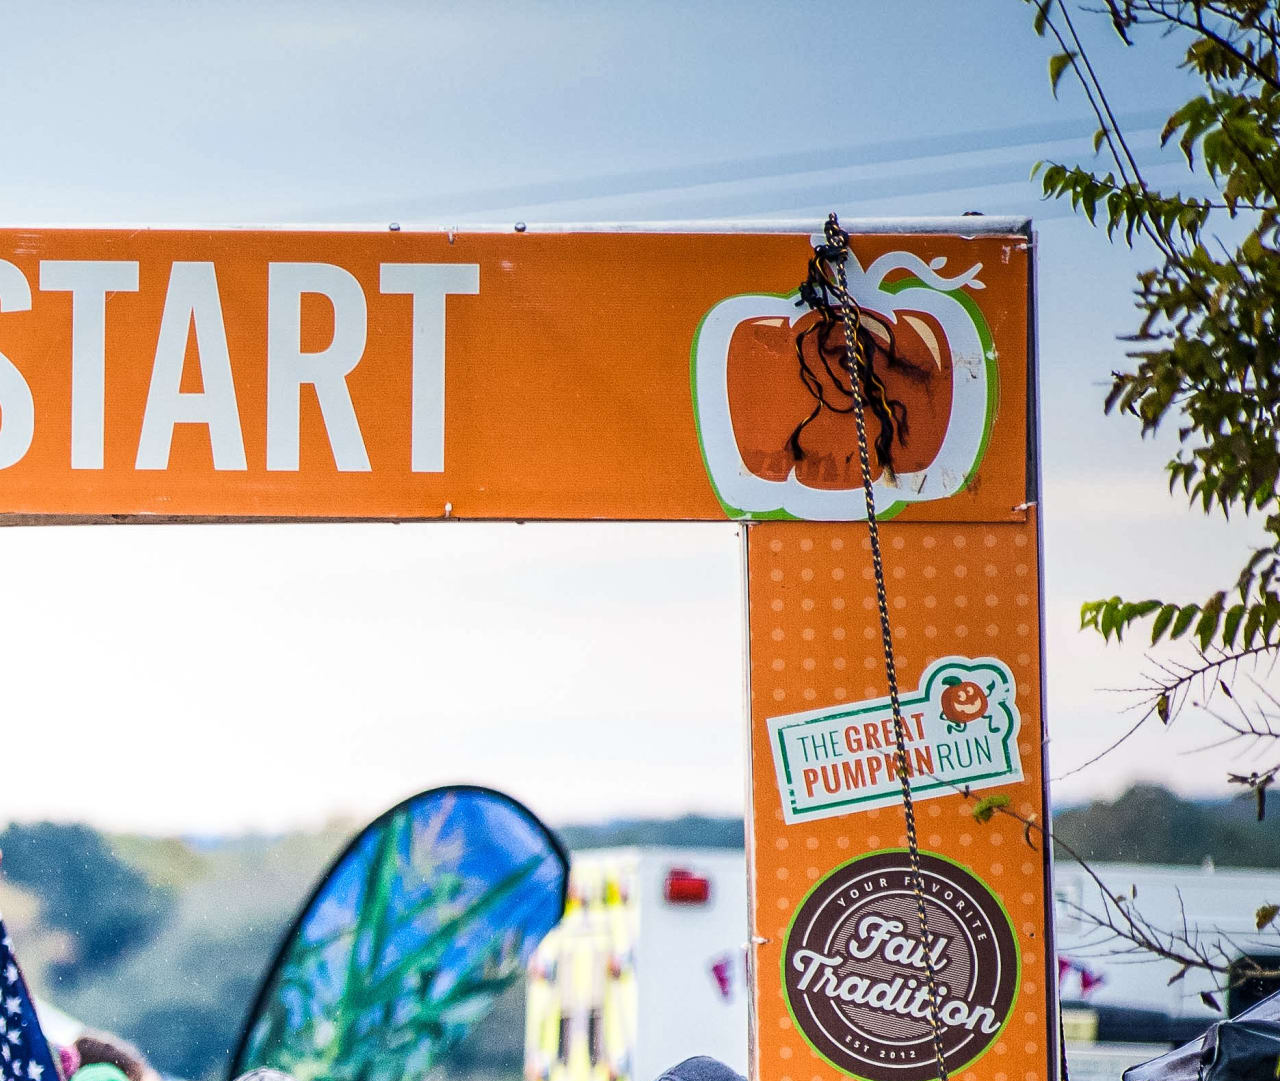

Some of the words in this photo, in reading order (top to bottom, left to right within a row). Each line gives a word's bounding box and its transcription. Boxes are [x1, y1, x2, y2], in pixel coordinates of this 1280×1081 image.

[797, 730, 842, 763] THE
[844, 712, 927, 753] GREAT
[937, 736, 993, 773] RUN
[837, 878, 888, 908] YOUR
[904, 876, 986, 941] FAVORITE
[793, 949, 1001, 1034] Tradition
[845, 1035, 870, 1053] EST
[879, 1050, 917, 1059] 2012
